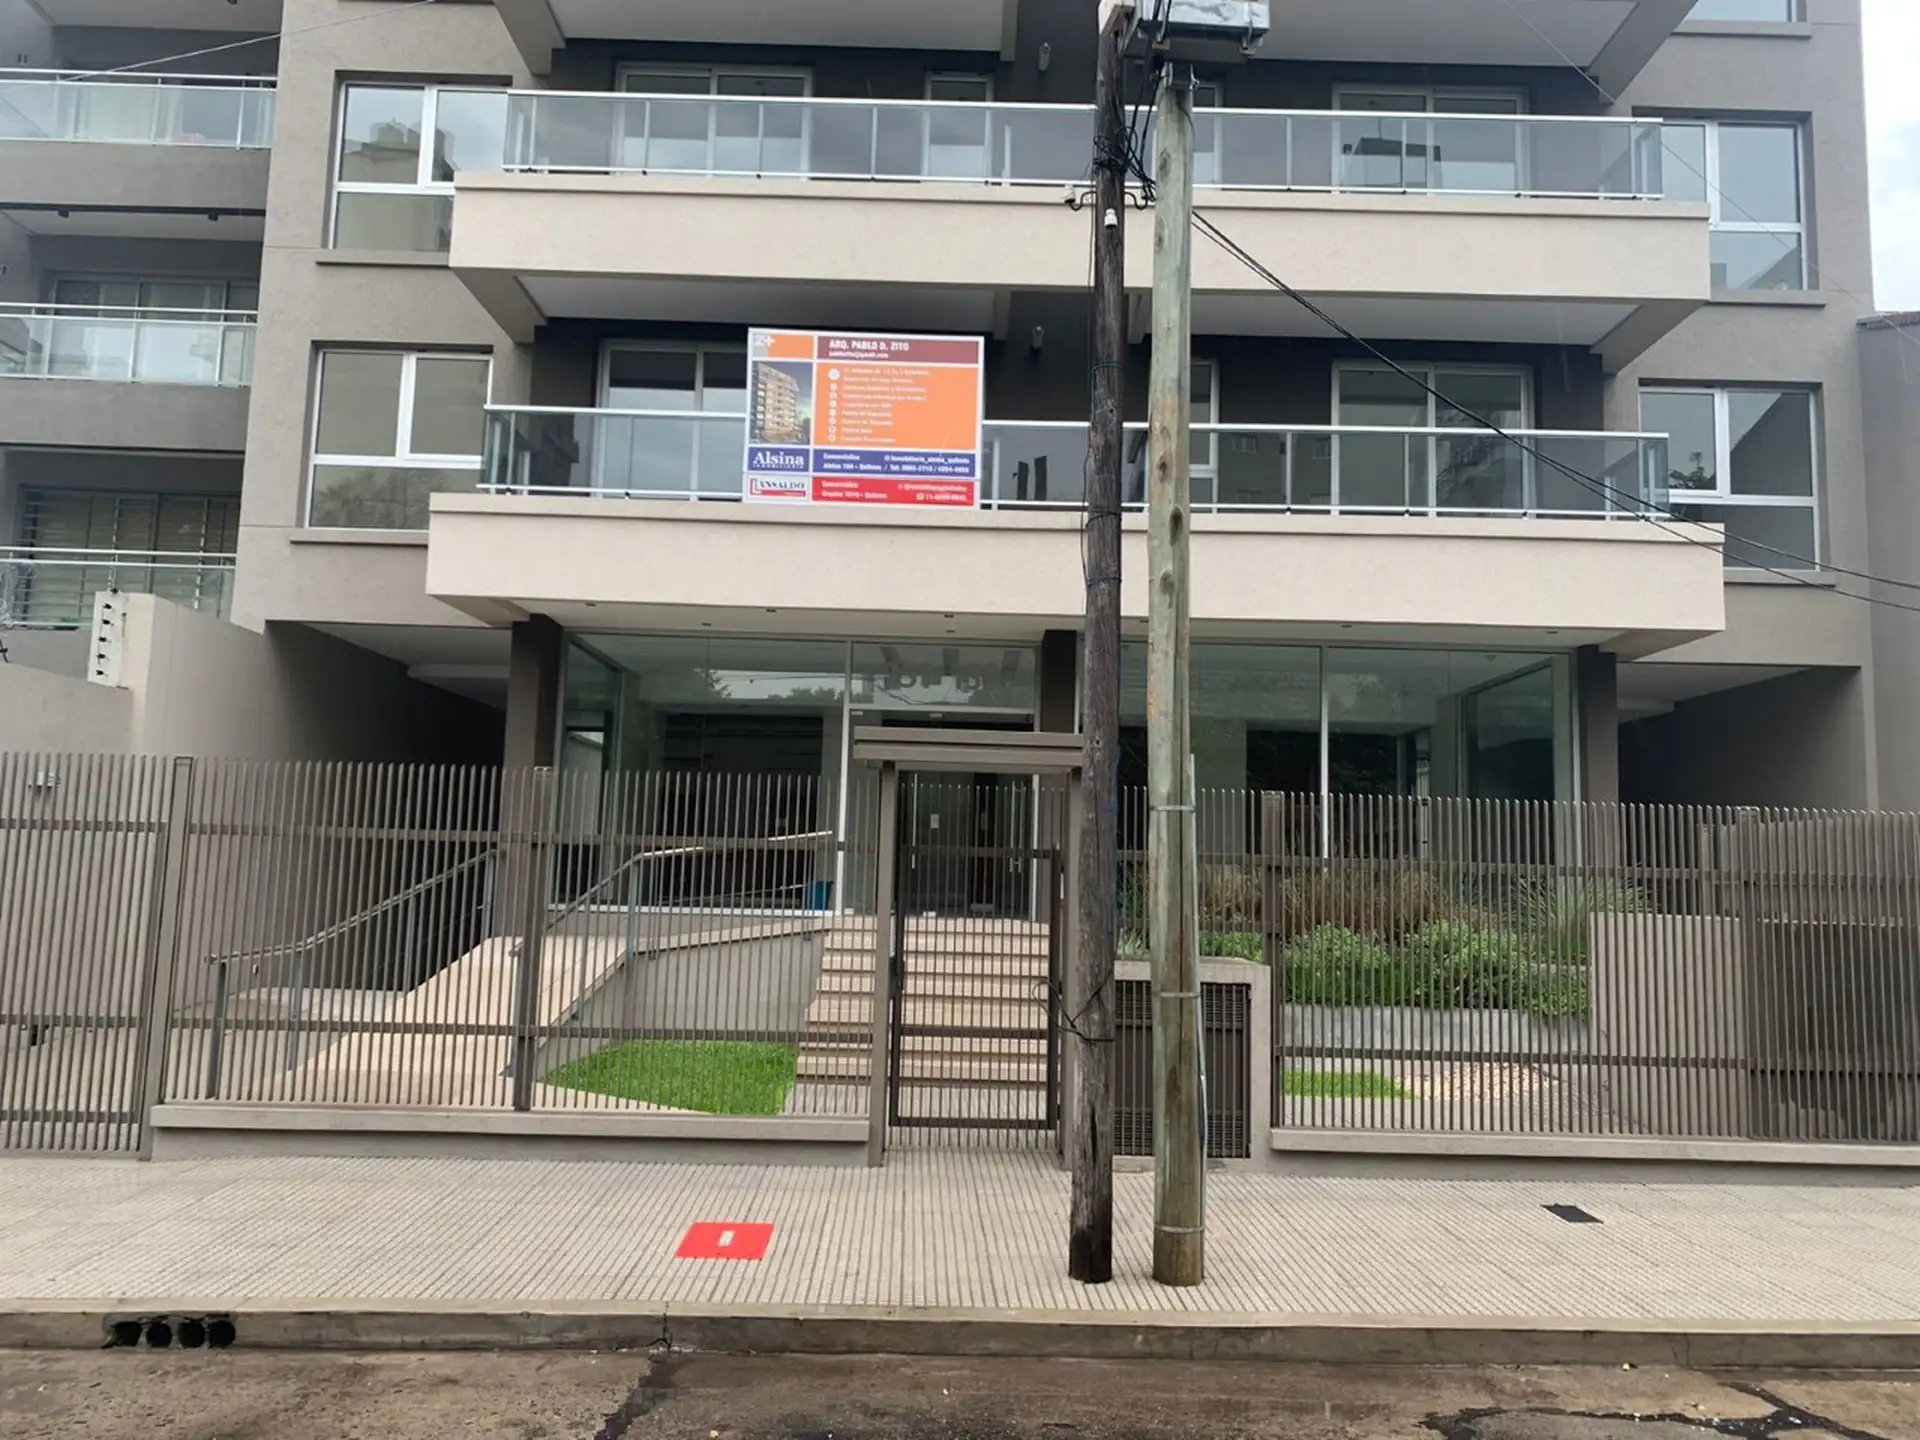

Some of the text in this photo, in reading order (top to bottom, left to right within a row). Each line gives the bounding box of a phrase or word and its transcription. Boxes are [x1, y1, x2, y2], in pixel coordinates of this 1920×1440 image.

[851, 340, 878, 351] PABLO
[890, 341, 910, 352] ZITO
[752, 451, 804, 465] Alsina
